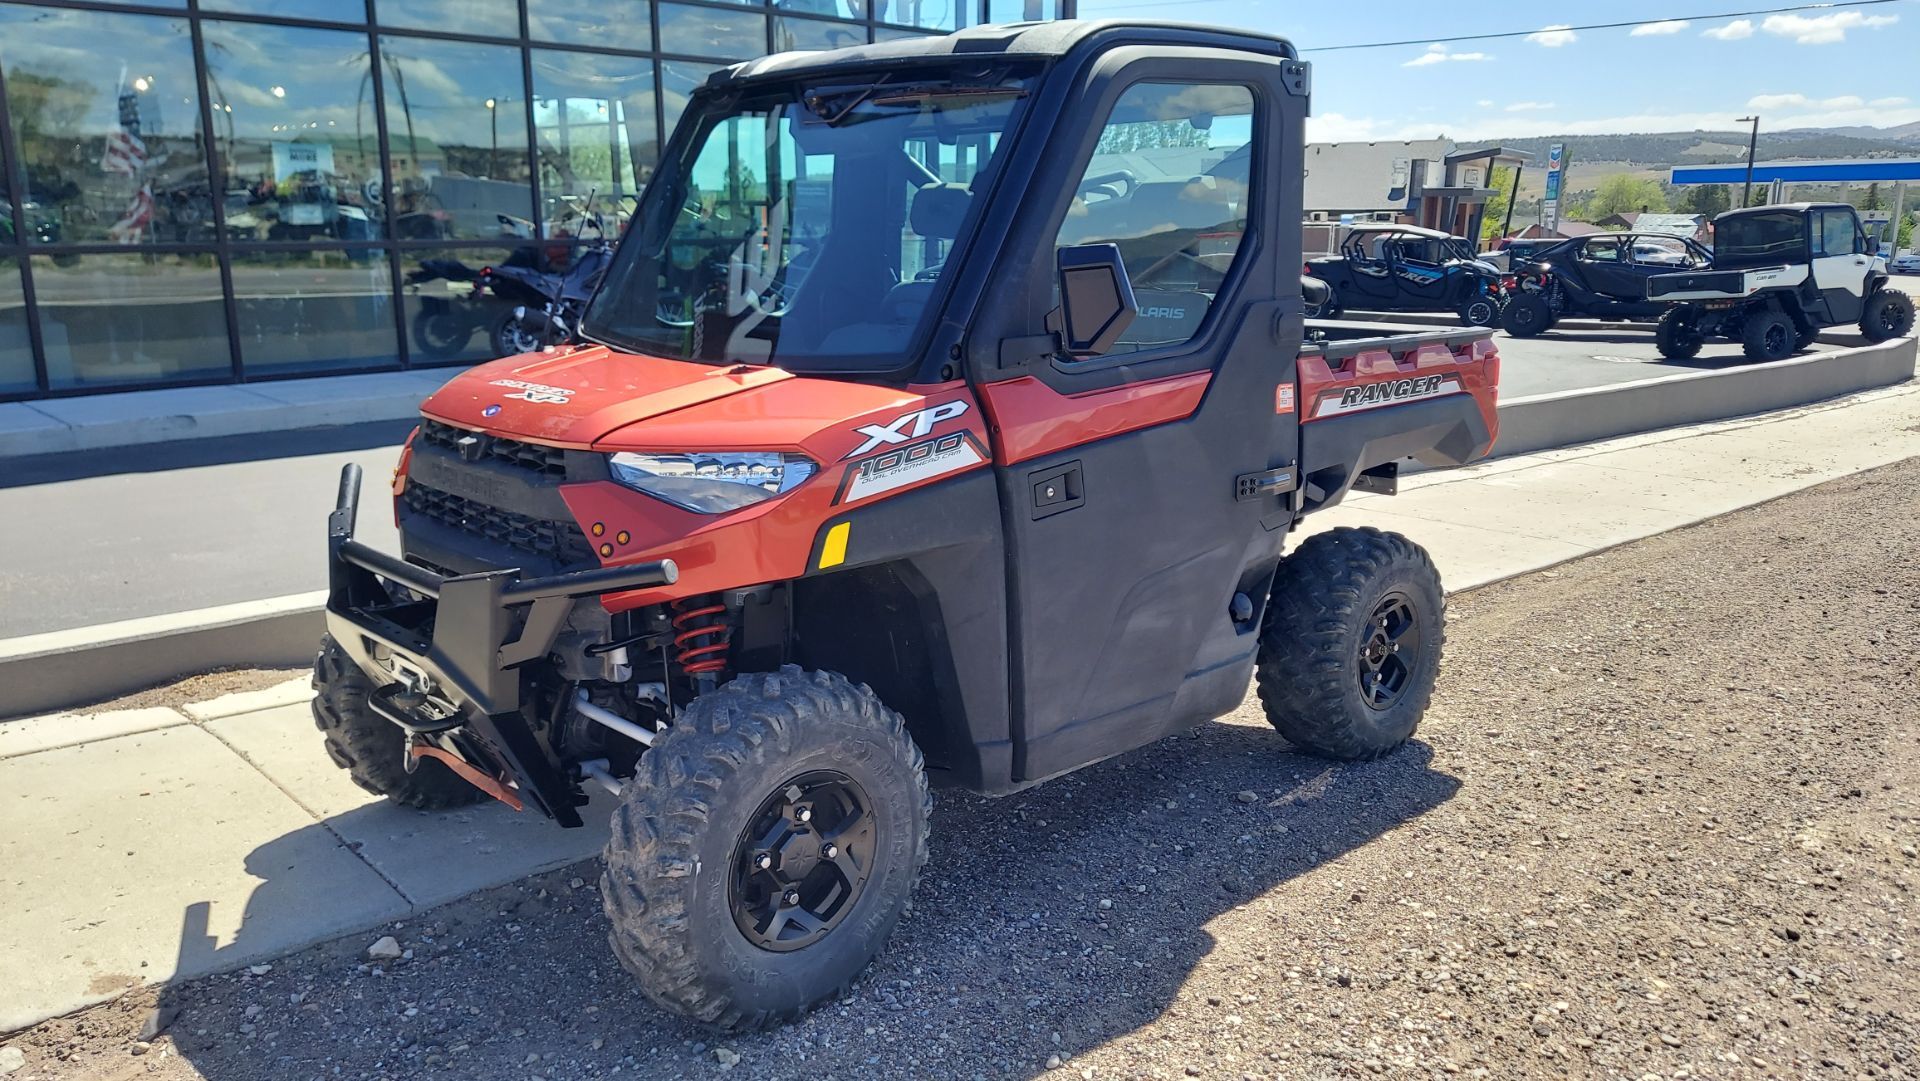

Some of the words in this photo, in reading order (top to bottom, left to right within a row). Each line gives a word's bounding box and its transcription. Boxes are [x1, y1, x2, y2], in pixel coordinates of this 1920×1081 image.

[1137, 306, 1185, 319] LARIS
[1339, 374, 1443, 408] RANGER
[837, 399, 971, 462] XP
[858, 431, 966, 479] 1000
[861, 473, 888, 484] DUAL
[890, 457, 940, 476] OVERHEAD
[941, 449, 962, 460] CAM
